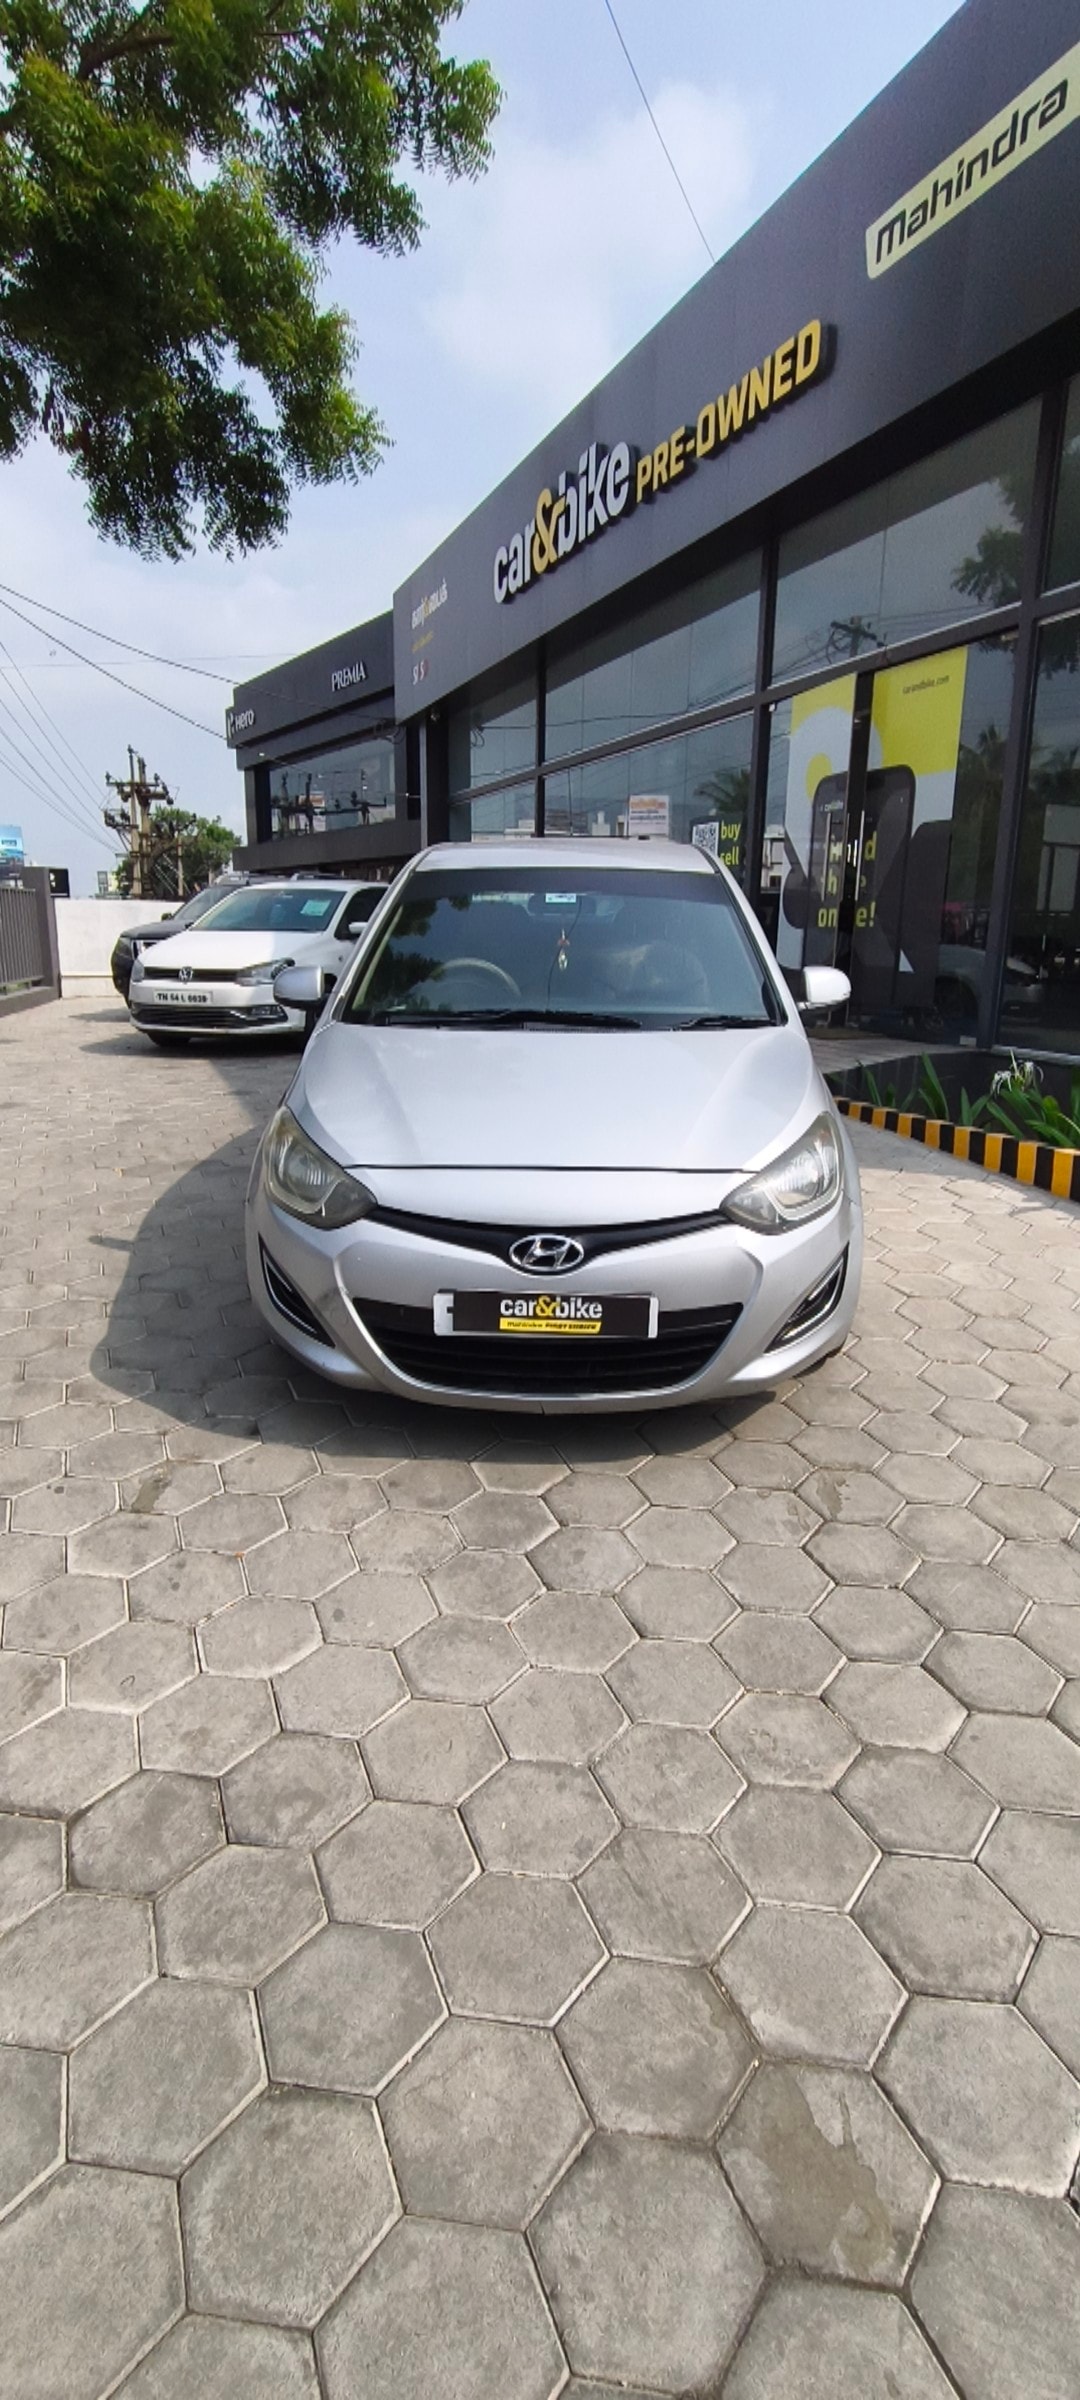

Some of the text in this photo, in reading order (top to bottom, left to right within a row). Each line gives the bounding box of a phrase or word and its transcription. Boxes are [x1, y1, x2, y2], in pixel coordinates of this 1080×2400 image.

[876, 78, 1068, 265] Mahindra
[493, 318, 822, 604] car&bike PRE-OWNED
[331, 661, 366, 692] PREMIA
[234, 708, 255, 732] Hero
[721, 820, 741, 842] buy
[500, 1295, 603, 1319] car&bike
